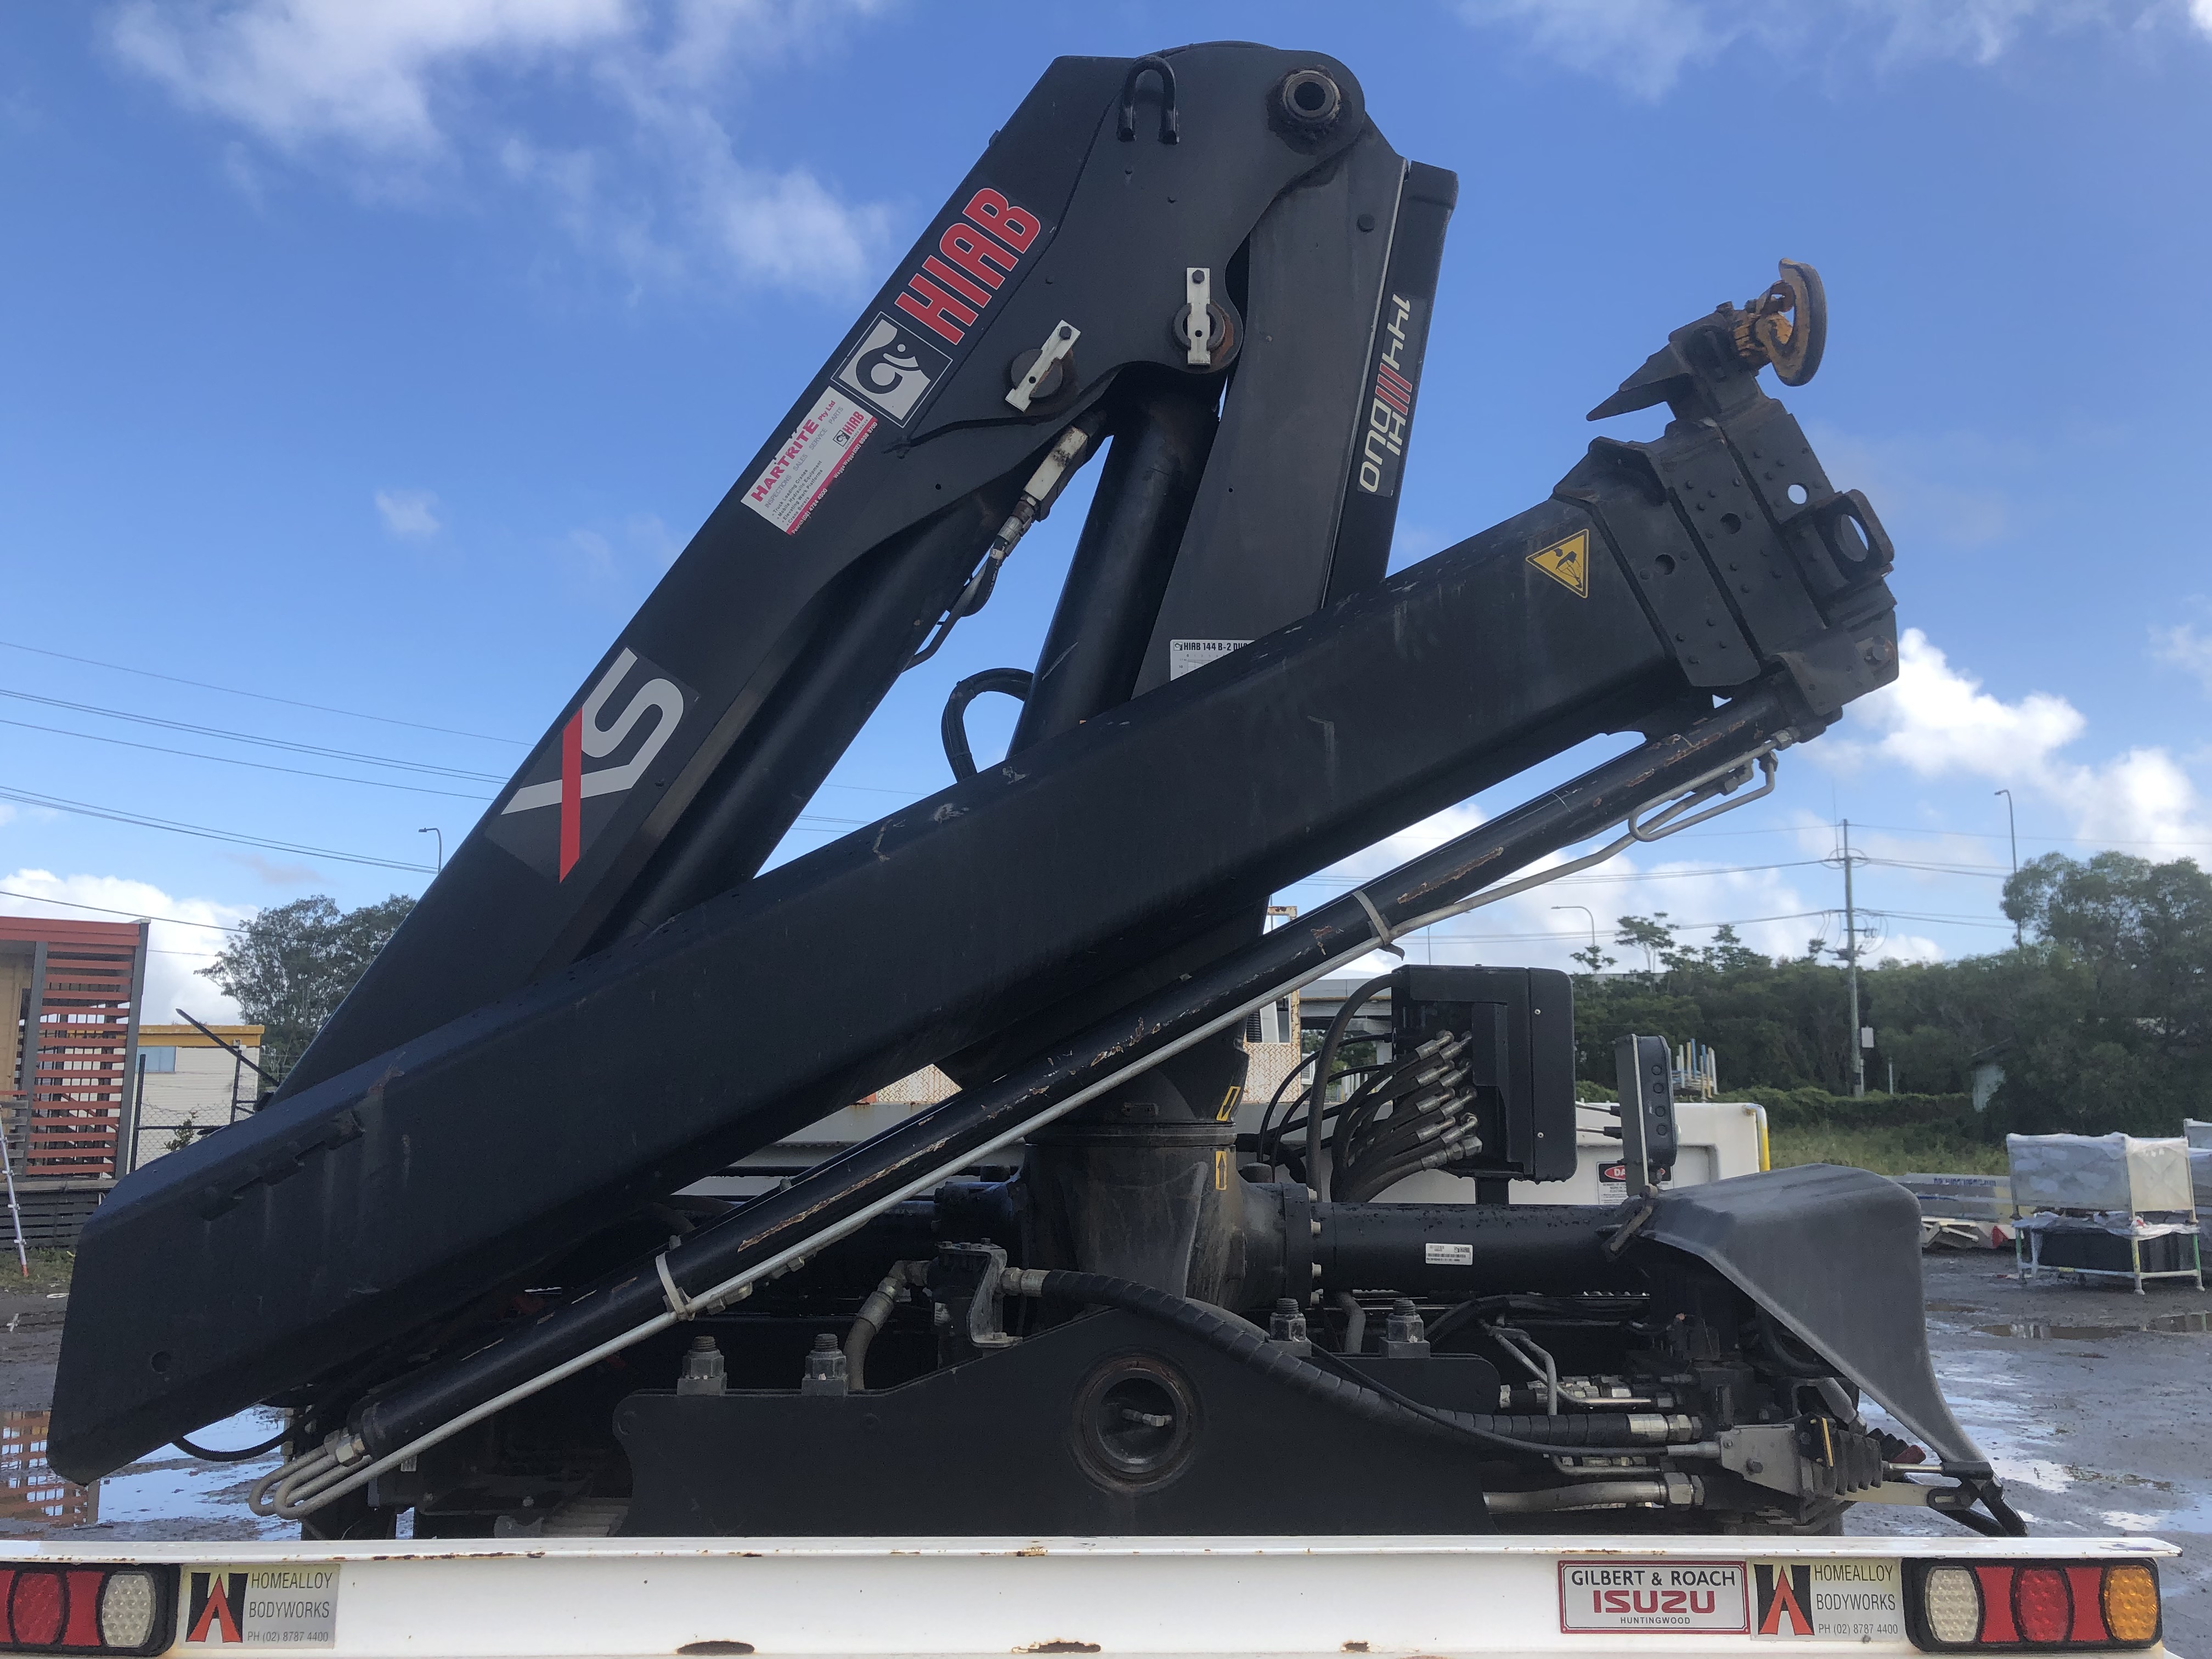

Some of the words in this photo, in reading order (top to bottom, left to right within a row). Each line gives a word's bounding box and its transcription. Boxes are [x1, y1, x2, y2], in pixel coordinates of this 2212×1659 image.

[894, 188, 1041, 345] HIAB
[1382, 294, 1410, 370] 144
[842, 411, 865, 435] HIAB
[1386, 411, 1406, 456] HI
[751, 419, 820, 502] HARTRITE
[817, 410, 828, 421] Pty
[825, 400, 836, 411] Ltd
[764, 475, 792, 509] INSPECTIONS
[793, 454, 808, 471] SALES
[809, 427, 828, 450] SERVICE
[828, 407, 844, 425] PARTS
[1360, 398, 1392, 493] DUO
[772, 501, 784, 513] Truck
[782, 484, 798, 501] Loading
[795, 469, 808, 484] Cranes
[777, 503, 790, 517] Mobile
[788, 483, 805, 503] Hydraulic
[803, 460, 822, 483] Equipment
[782, 500, 800, 521] Elevating
[797, 489, 808, 500] Work
[806, 469, 823, 489] Platforms
[1184, 642, 1200, 651] HIAB
[1203, 642, 1216, 651] 144
[1218, 642, 1231, 651] B-2
[501, 647, 684, 883] XS
[251, 1572, 332, 1589] HOMEALLOY
[1572, 1570, 1647, 1586] GILBERT
[1652, 1571, 1663, 1586] &
[1671, 1571, 1736, 1586] ROACH
[1814, 1564, 1893, 1582] HOMEALLOY
[249, 1601, 330, 1619] BODYWORKS
[1593, 1590, 1715, 1613] ISUZU
[1816, 1593, 1896, 1611] BODYWORKS
[248, 1632, 260, 1642] PH
[262, 1632, 280, 1643] (02)
[283, 1632, 306, 1642] 8787
[308, 1632, 329, 1642] 4400
[1818, 1623, 1830, 1633] PH
[1833, 1623, 1851, 1634] (02)
[1853, 1624, 1874, 1634] 8787
[1877, 1624, 1898, 1634] 4400
